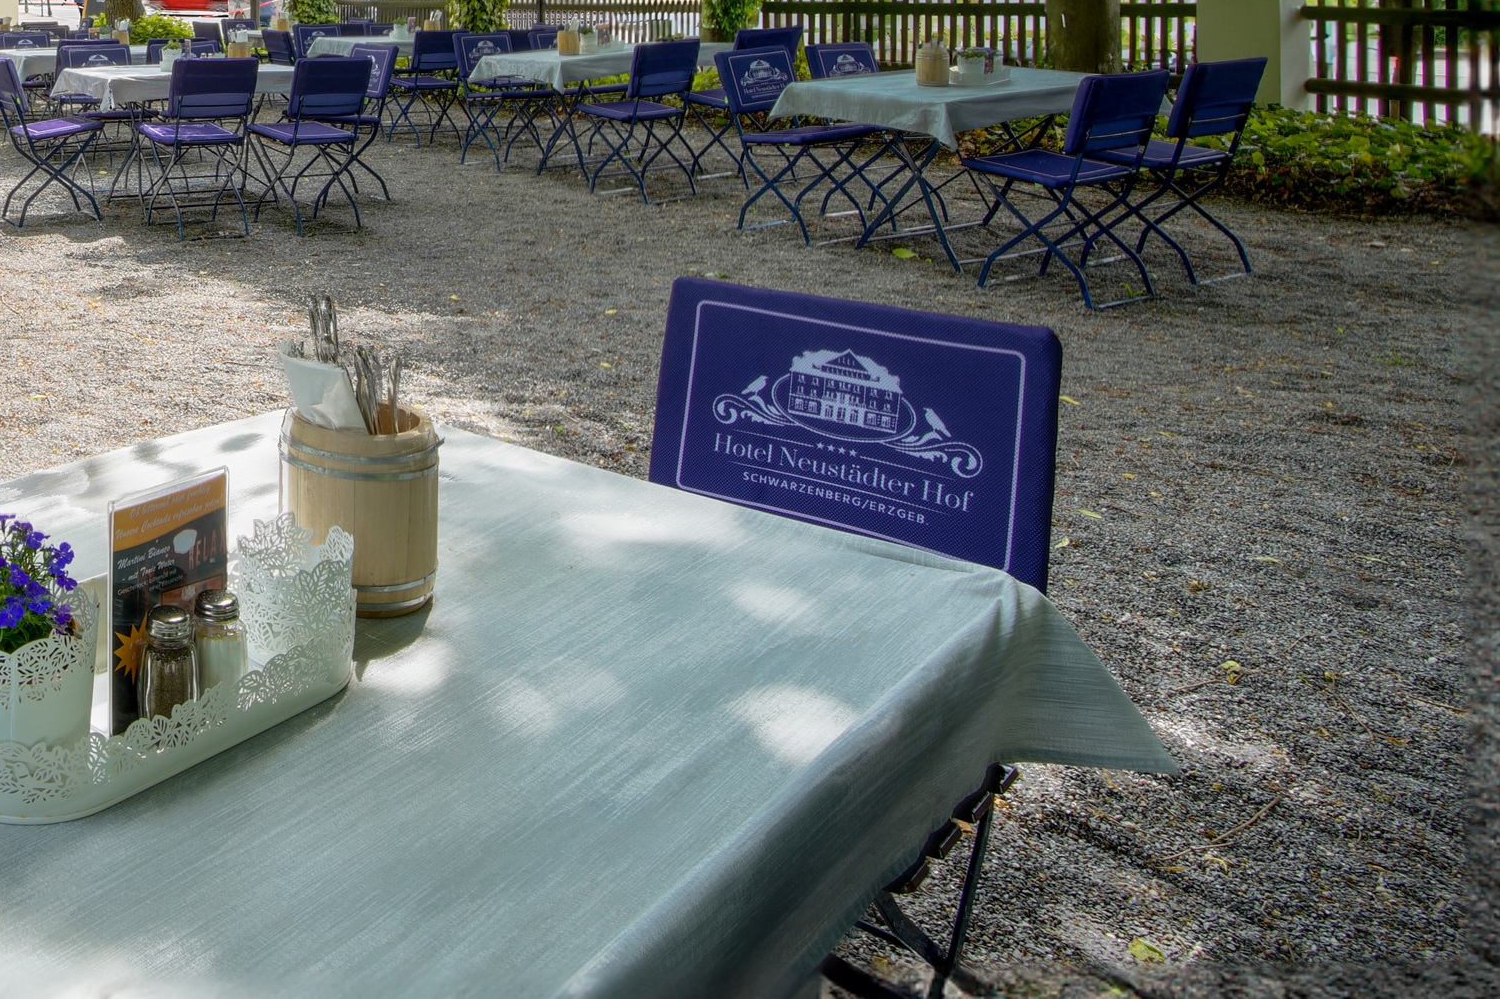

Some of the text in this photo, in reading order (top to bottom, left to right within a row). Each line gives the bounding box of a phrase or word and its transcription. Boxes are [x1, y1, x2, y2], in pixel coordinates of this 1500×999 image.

[714, 432, 974, 513] Hotel Neustädter Hof
[742, 471, 930, 526] SCHWARZENBERG/ERZGEB.
[117, 552, 147, 570] Martini
[188, 523, 228, 571] RELAX
